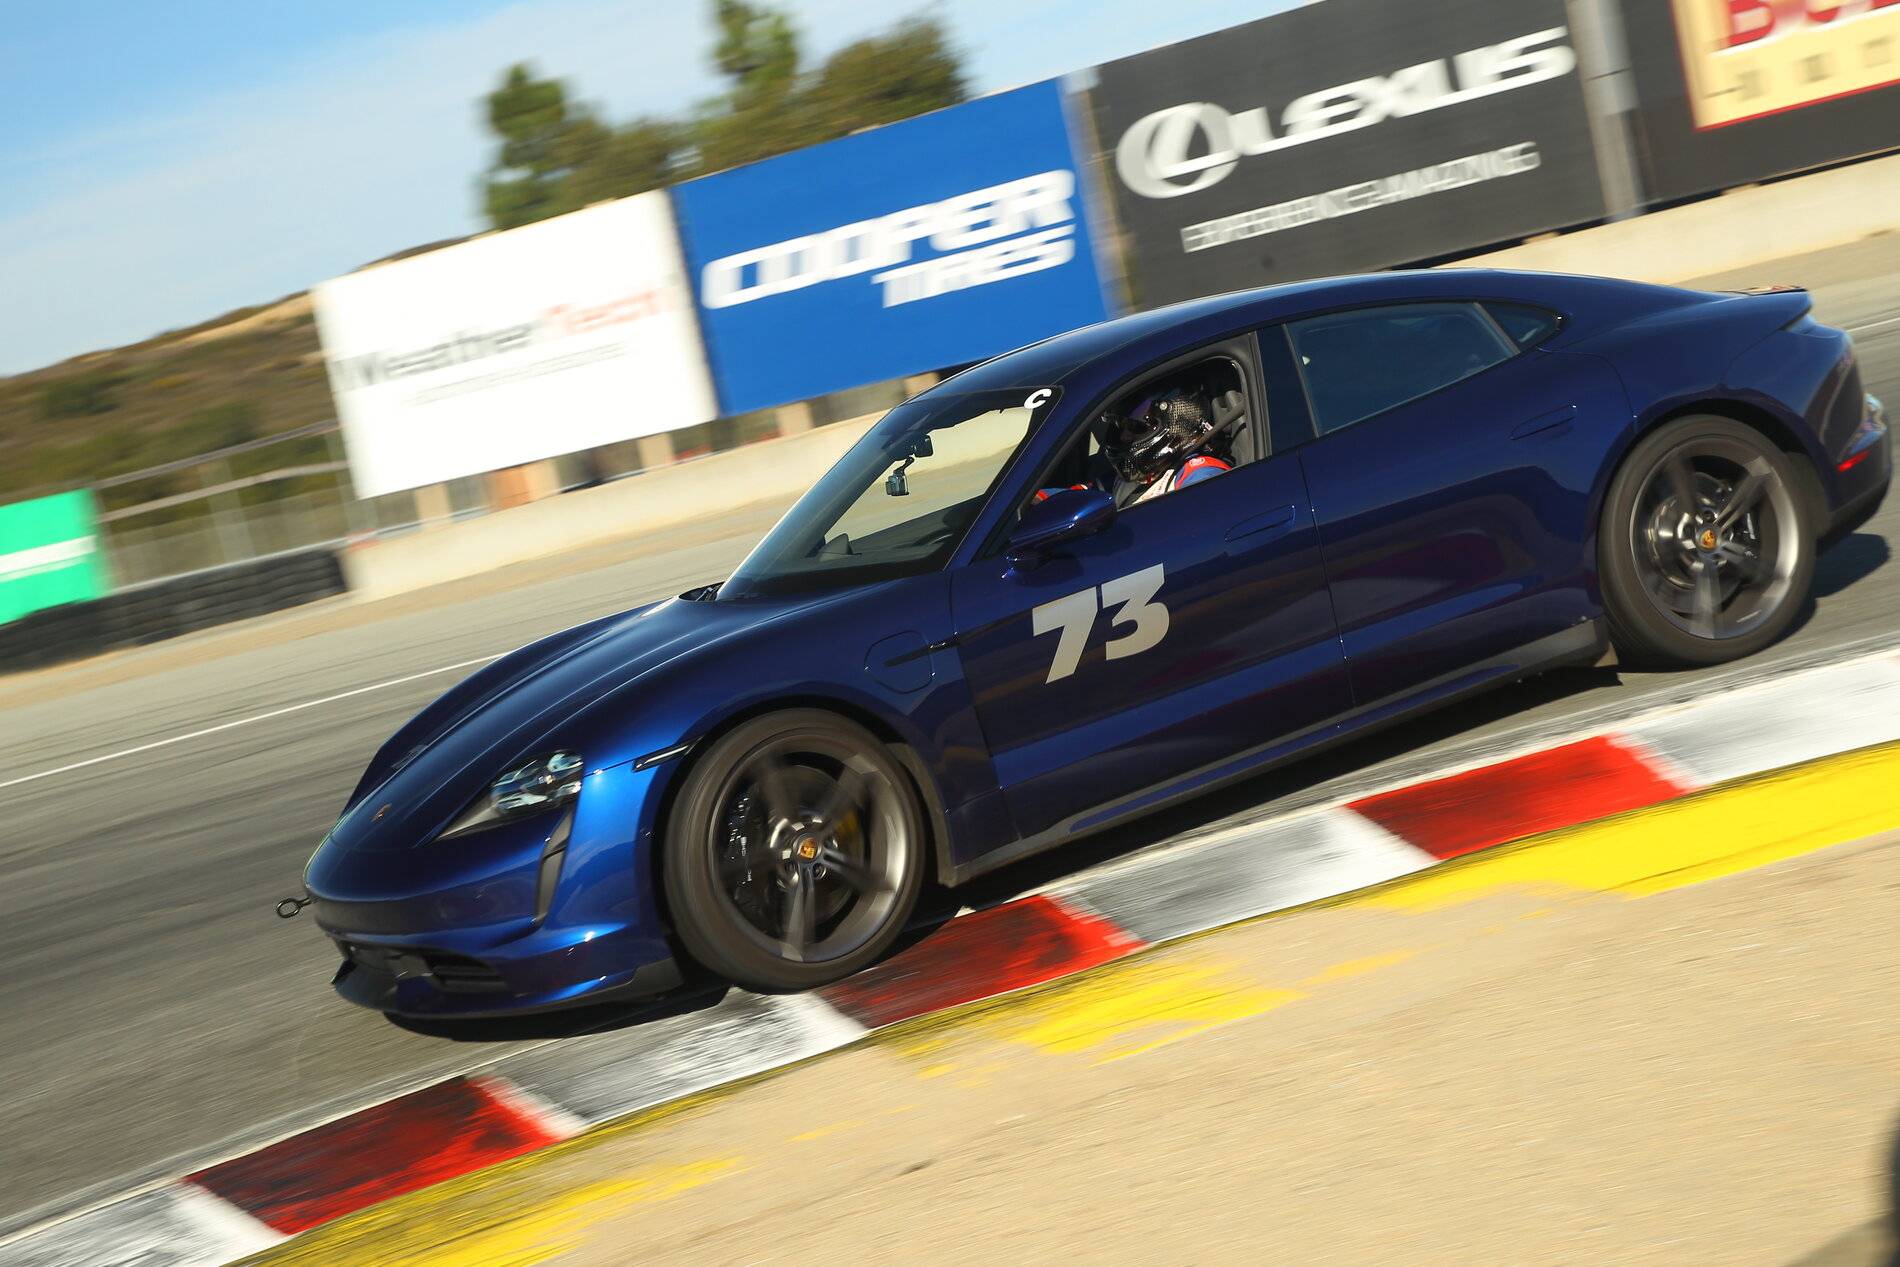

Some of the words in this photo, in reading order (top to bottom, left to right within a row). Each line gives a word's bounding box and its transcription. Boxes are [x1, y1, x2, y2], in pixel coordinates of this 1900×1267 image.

[1227, 26, 1578, 157] LEXUS
[701, 168, 1075, 310] COOPER
[871, 223, 1075, 309] TIRES
[1023, 388, 1052, 410] C
[1032, 562, 1170, 685] 73
